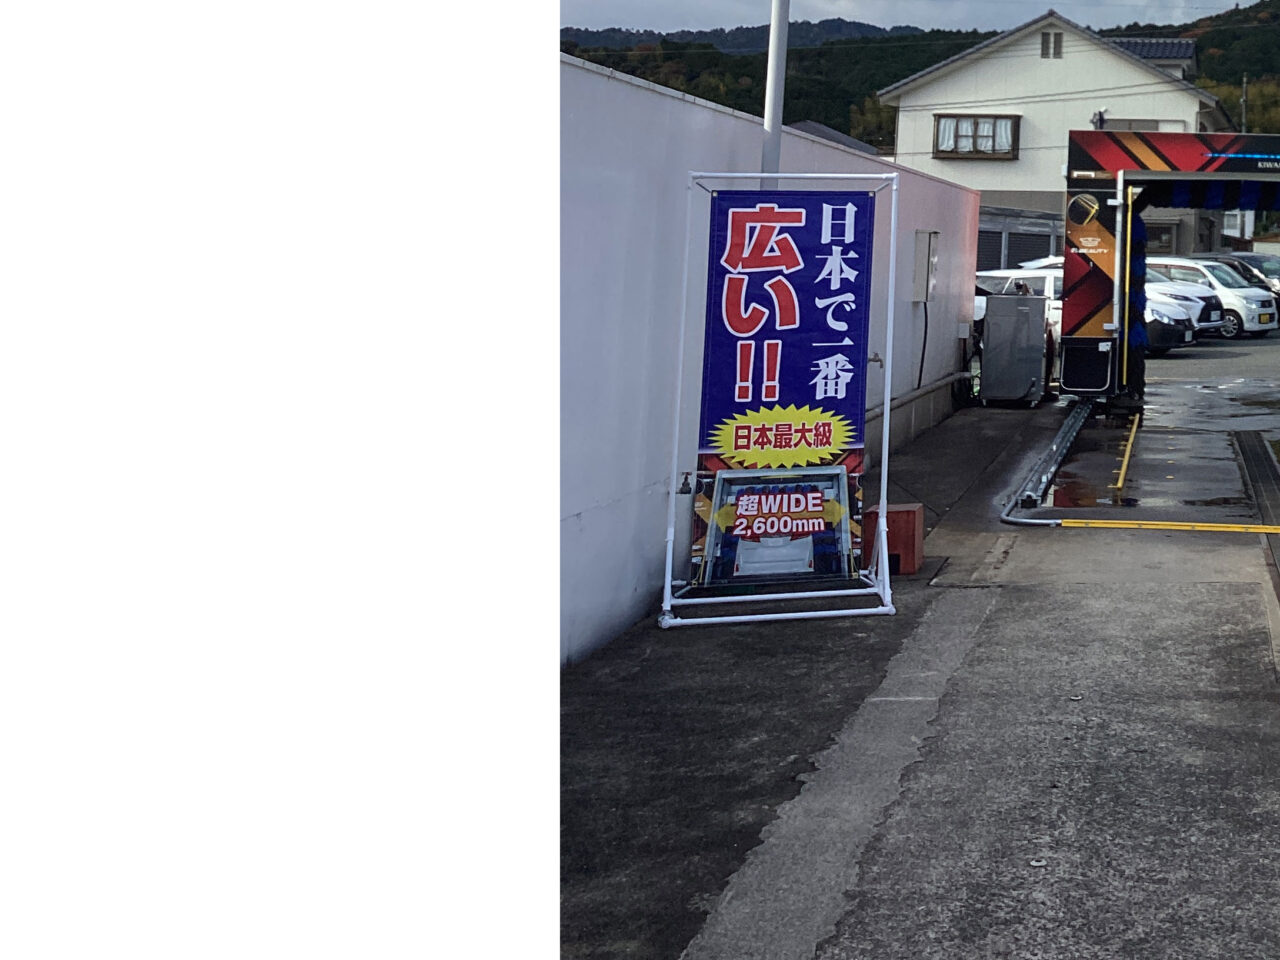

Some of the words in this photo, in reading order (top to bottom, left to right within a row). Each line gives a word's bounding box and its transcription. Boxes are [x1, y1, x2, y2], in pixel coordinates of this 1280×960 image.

[720, 203, 807, 403] 広い!!
[809, 201, 860, 401] 日本で一番
[733, 421, 833, 451] 日本最大級
[736, 492, 824, 516] 超WIDE
[733, 516, 826, 537] 2,600mm
